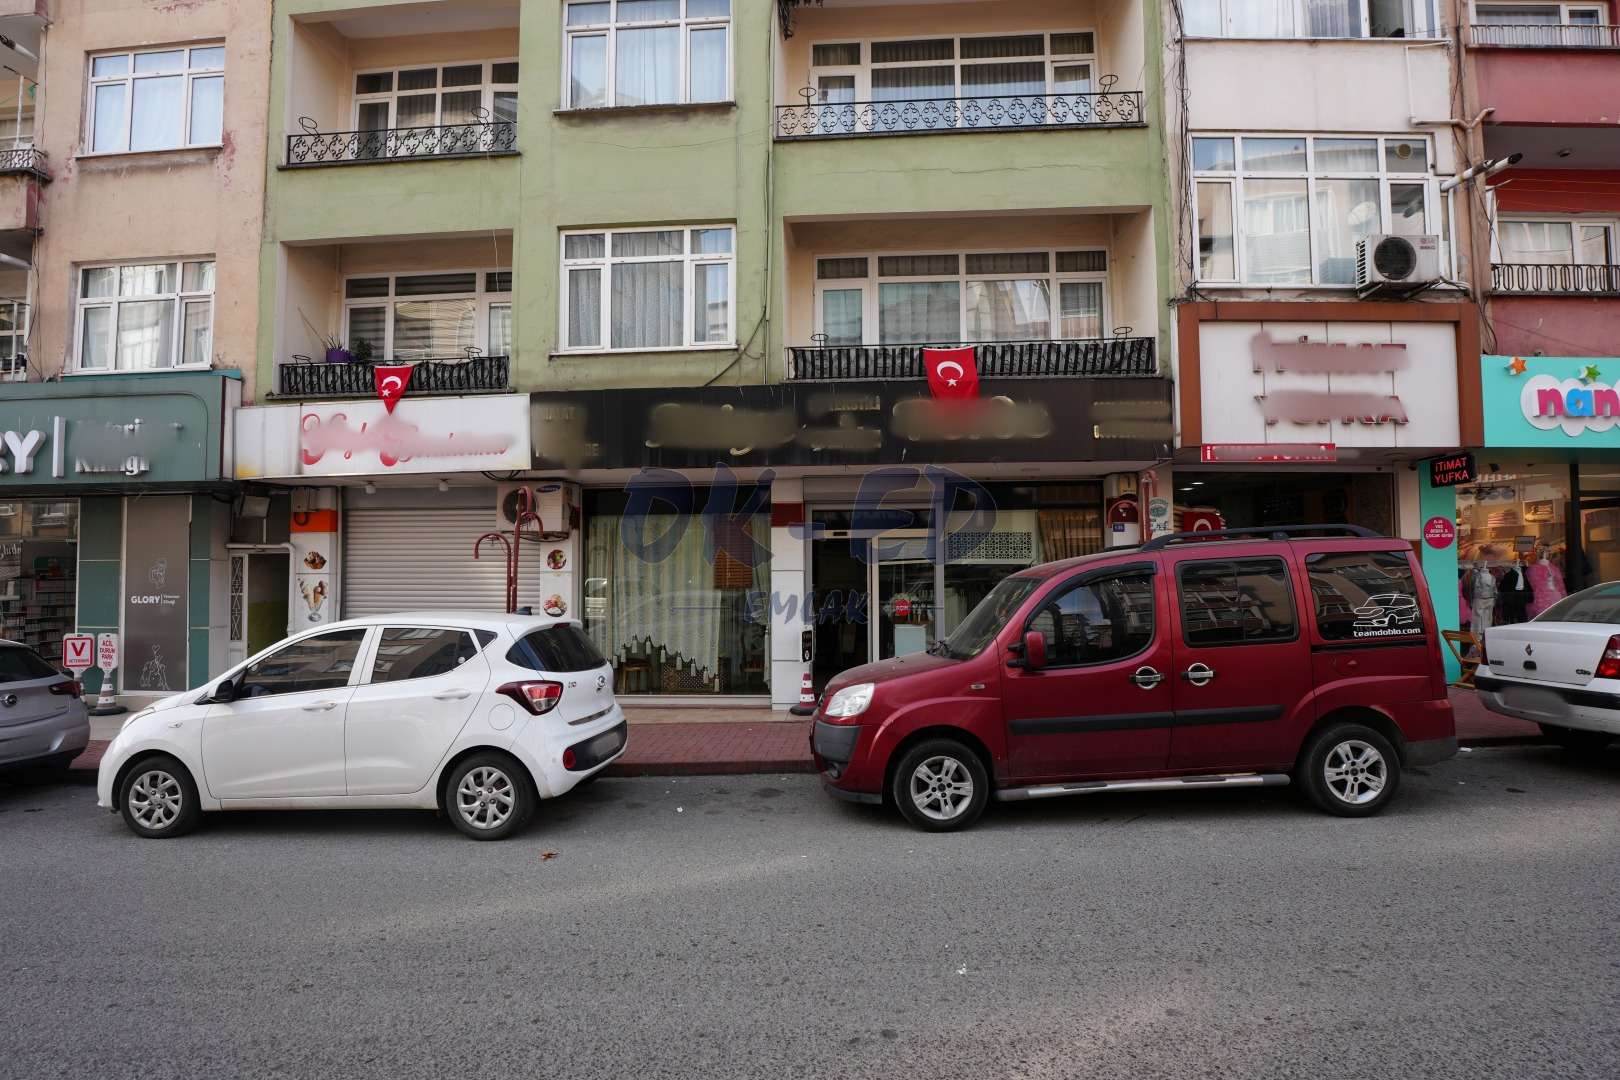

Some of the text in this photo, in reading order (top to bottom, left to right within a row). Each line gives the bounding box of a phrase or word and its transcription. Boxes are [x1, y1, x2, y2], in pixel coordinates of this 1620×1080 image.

[1434, 470, 1469, 485] YUFKA
[131, 595, 160, 604] GLORY
[1353, 628, 1421, 637] teamdoblo.com
[71, 641, 86, 657] V
